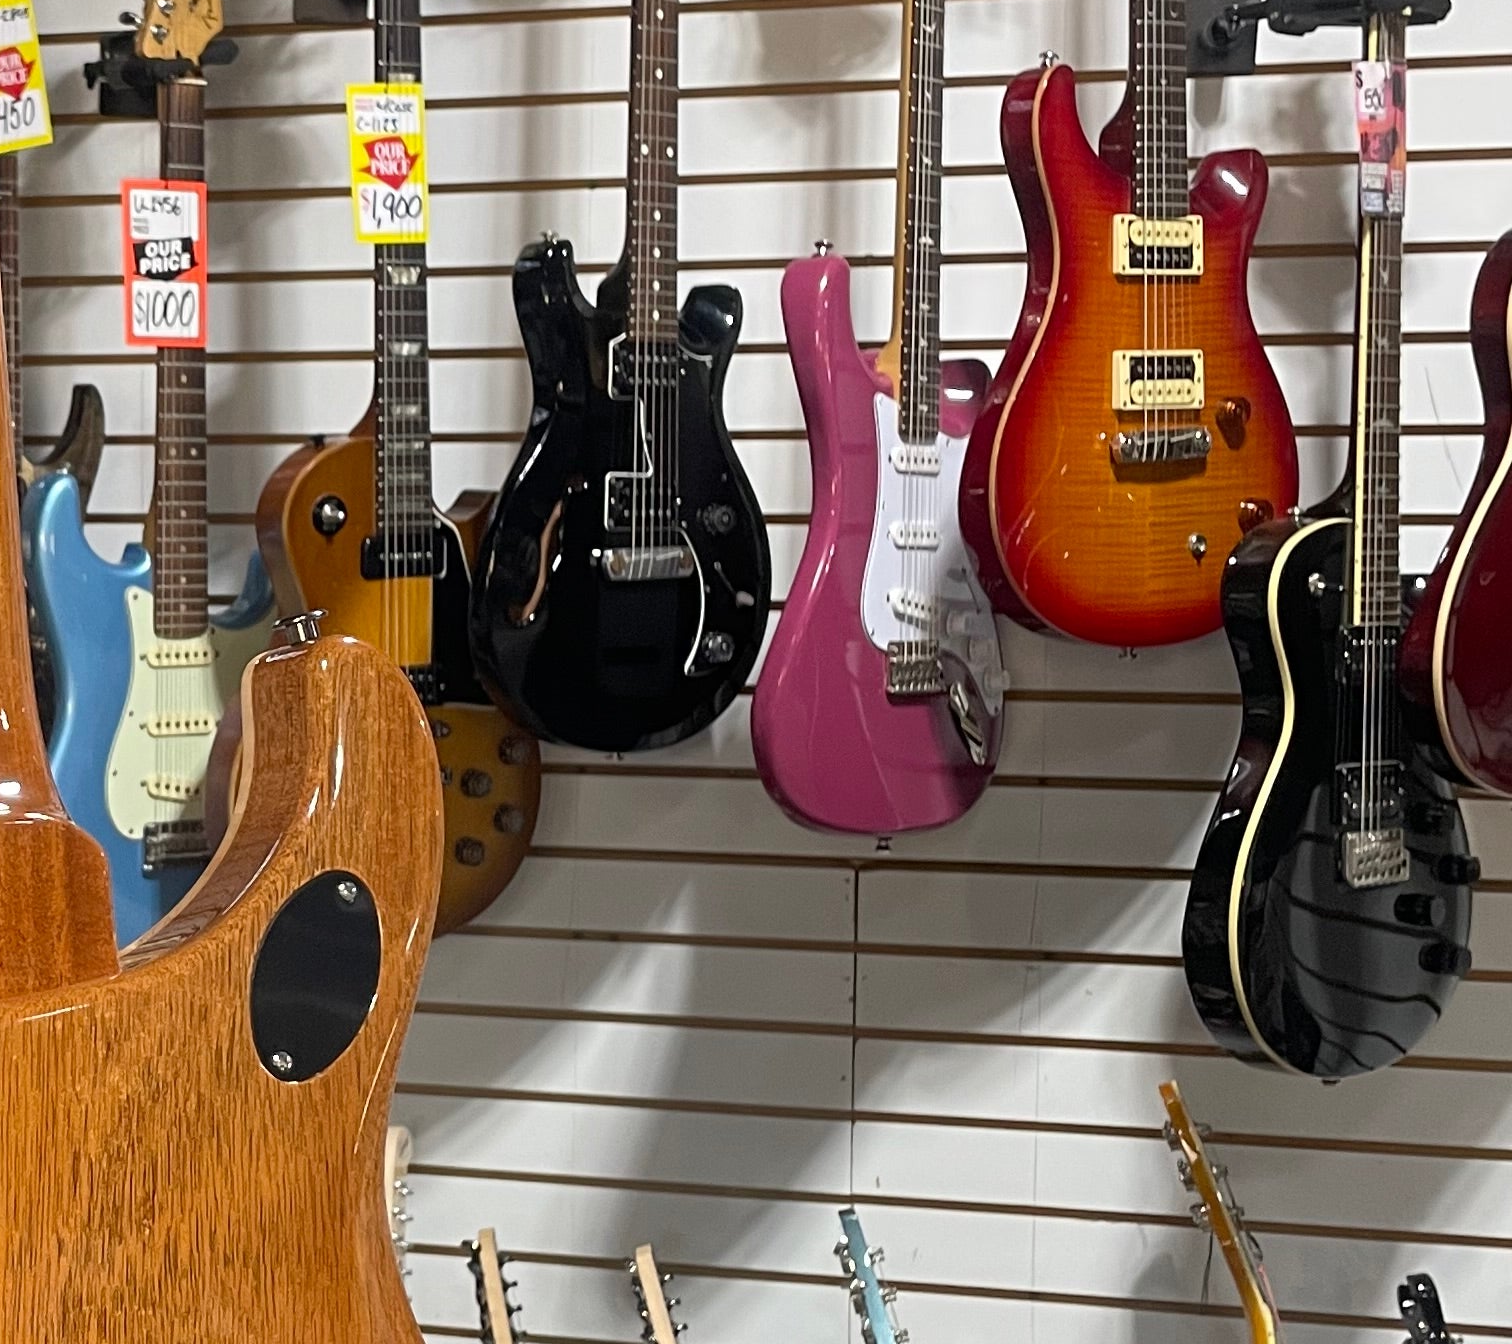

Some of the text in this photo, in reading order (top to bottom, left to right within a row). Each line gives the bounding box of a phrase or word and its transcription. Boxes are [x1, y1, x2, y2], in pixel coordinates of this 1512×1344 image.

[373, 142, 406, 160] OUR
[370, 158, 411, 176] PRICE
[144, 239, 183, 258] OUR
[139, 252, 192, 275] PRICE
[134, 289, 196, 333] $1000
